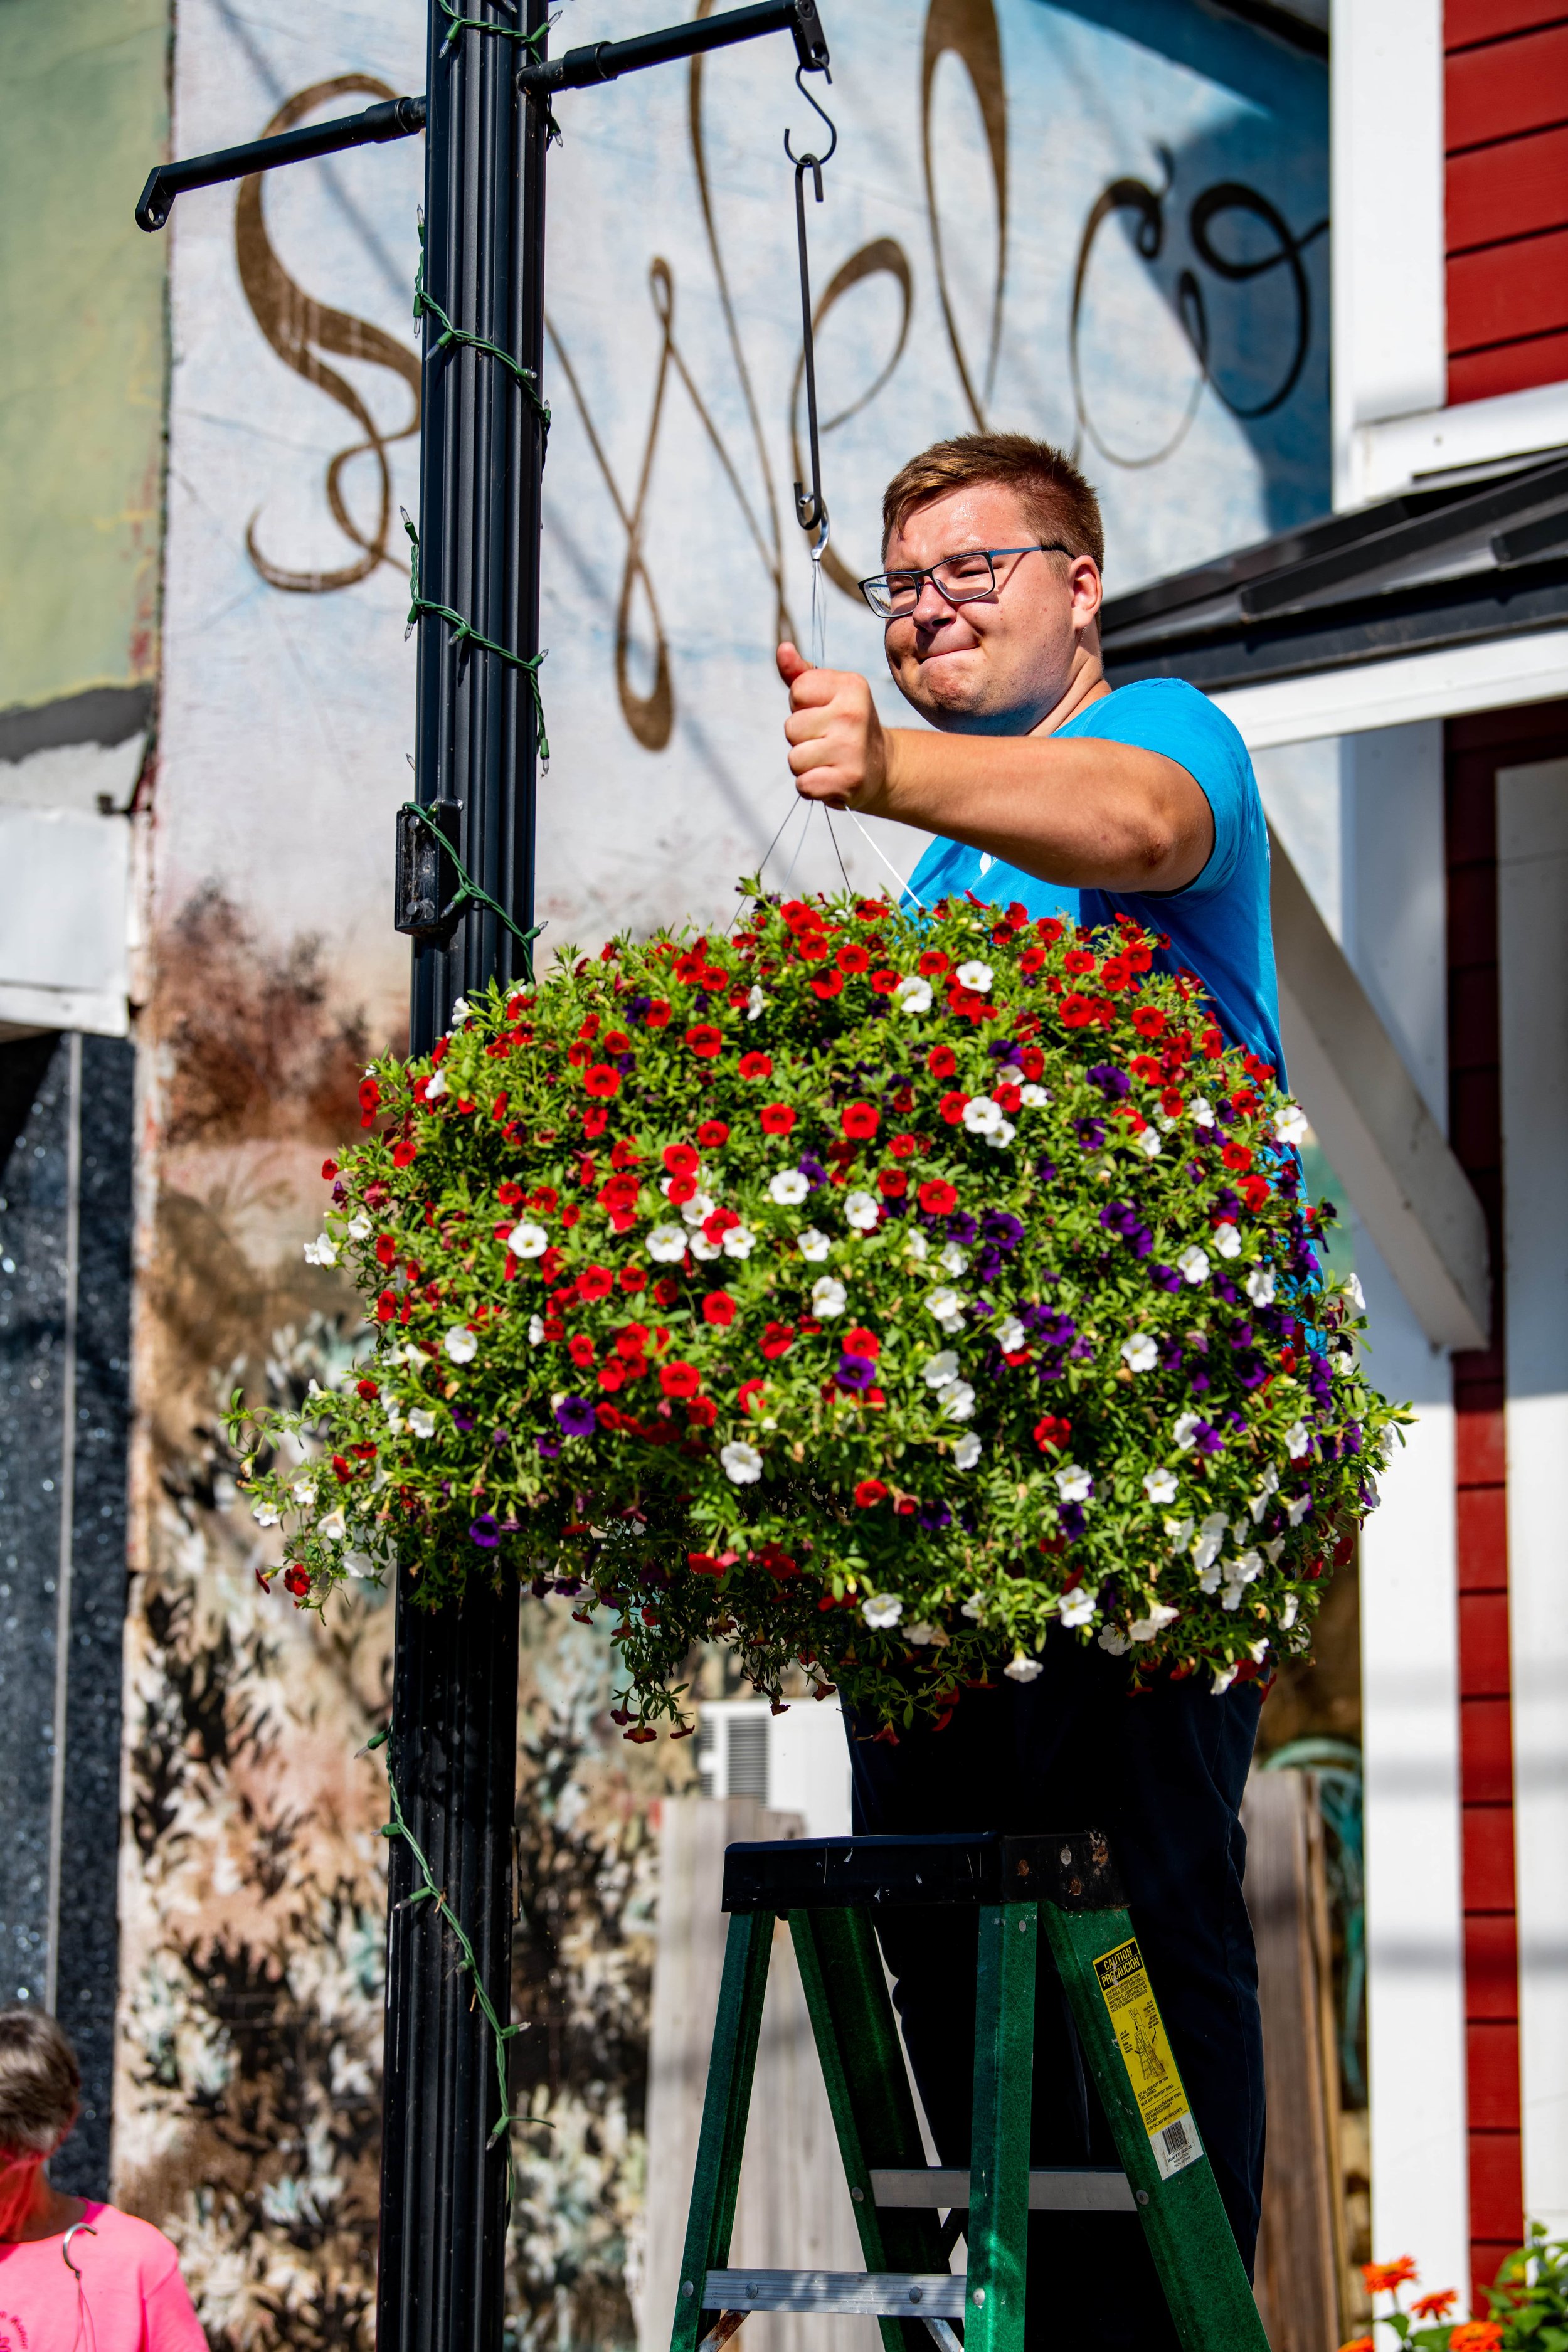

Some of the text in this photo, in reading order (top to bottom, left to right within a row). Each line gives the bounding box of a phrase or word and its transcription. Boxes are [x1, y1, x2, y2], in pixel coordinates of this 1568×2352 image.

[1103, 1946, 1133, 1971] CAUTION
[1101, 1956, 1140, 1987] PRECAUCIÓN
[1118, 1979, 1130, 1988] CENTERED
[1130, 1973, 1140, 1981] BETWEEN
[1109, 1996, 1121, 2005] MANTENGA
[1133, 1981, 1145, 1990] CENTRADO
[1122, 1997, 1134, 2007] ESTIRARSE
[1153, 2089, 1165, 2099] RESISTANT
[1144, 2109, 1153, 2117] ASIENTE
[1158, 2100, 1167, 2109] CUATRO
[1153, 2119, 1163, 2127] CALZADO
